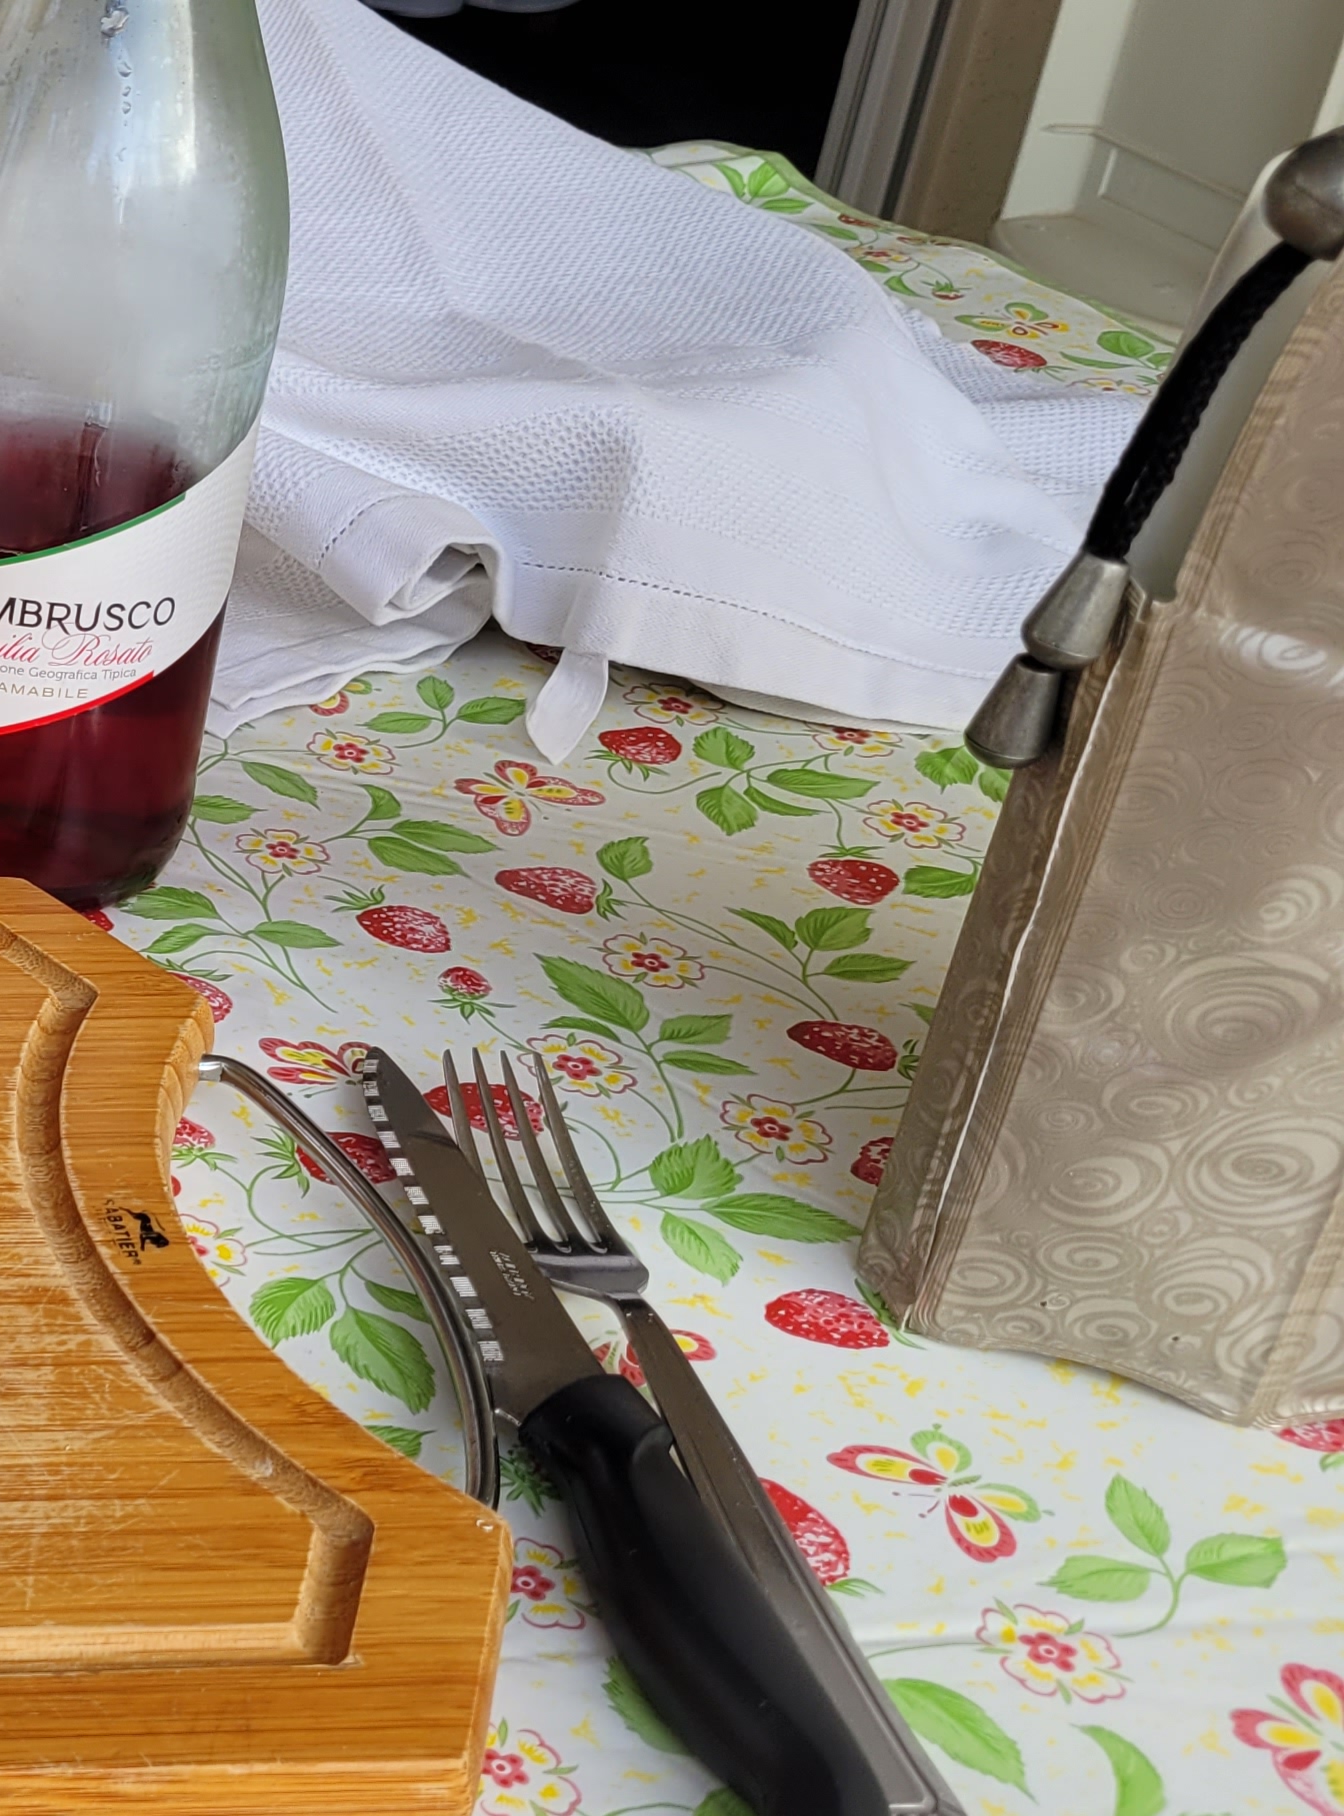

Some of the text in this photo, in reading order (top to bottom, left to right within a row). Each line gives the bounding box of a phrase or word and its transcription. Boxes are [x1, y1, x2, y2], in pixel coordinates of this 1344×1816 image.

[42, 632, 154, 667] Rosato
[28, 666, 98, 681] Geografica
[102, 668, 136, 682] Tipica
[104, 1199, 139, 1258] SABATIER
